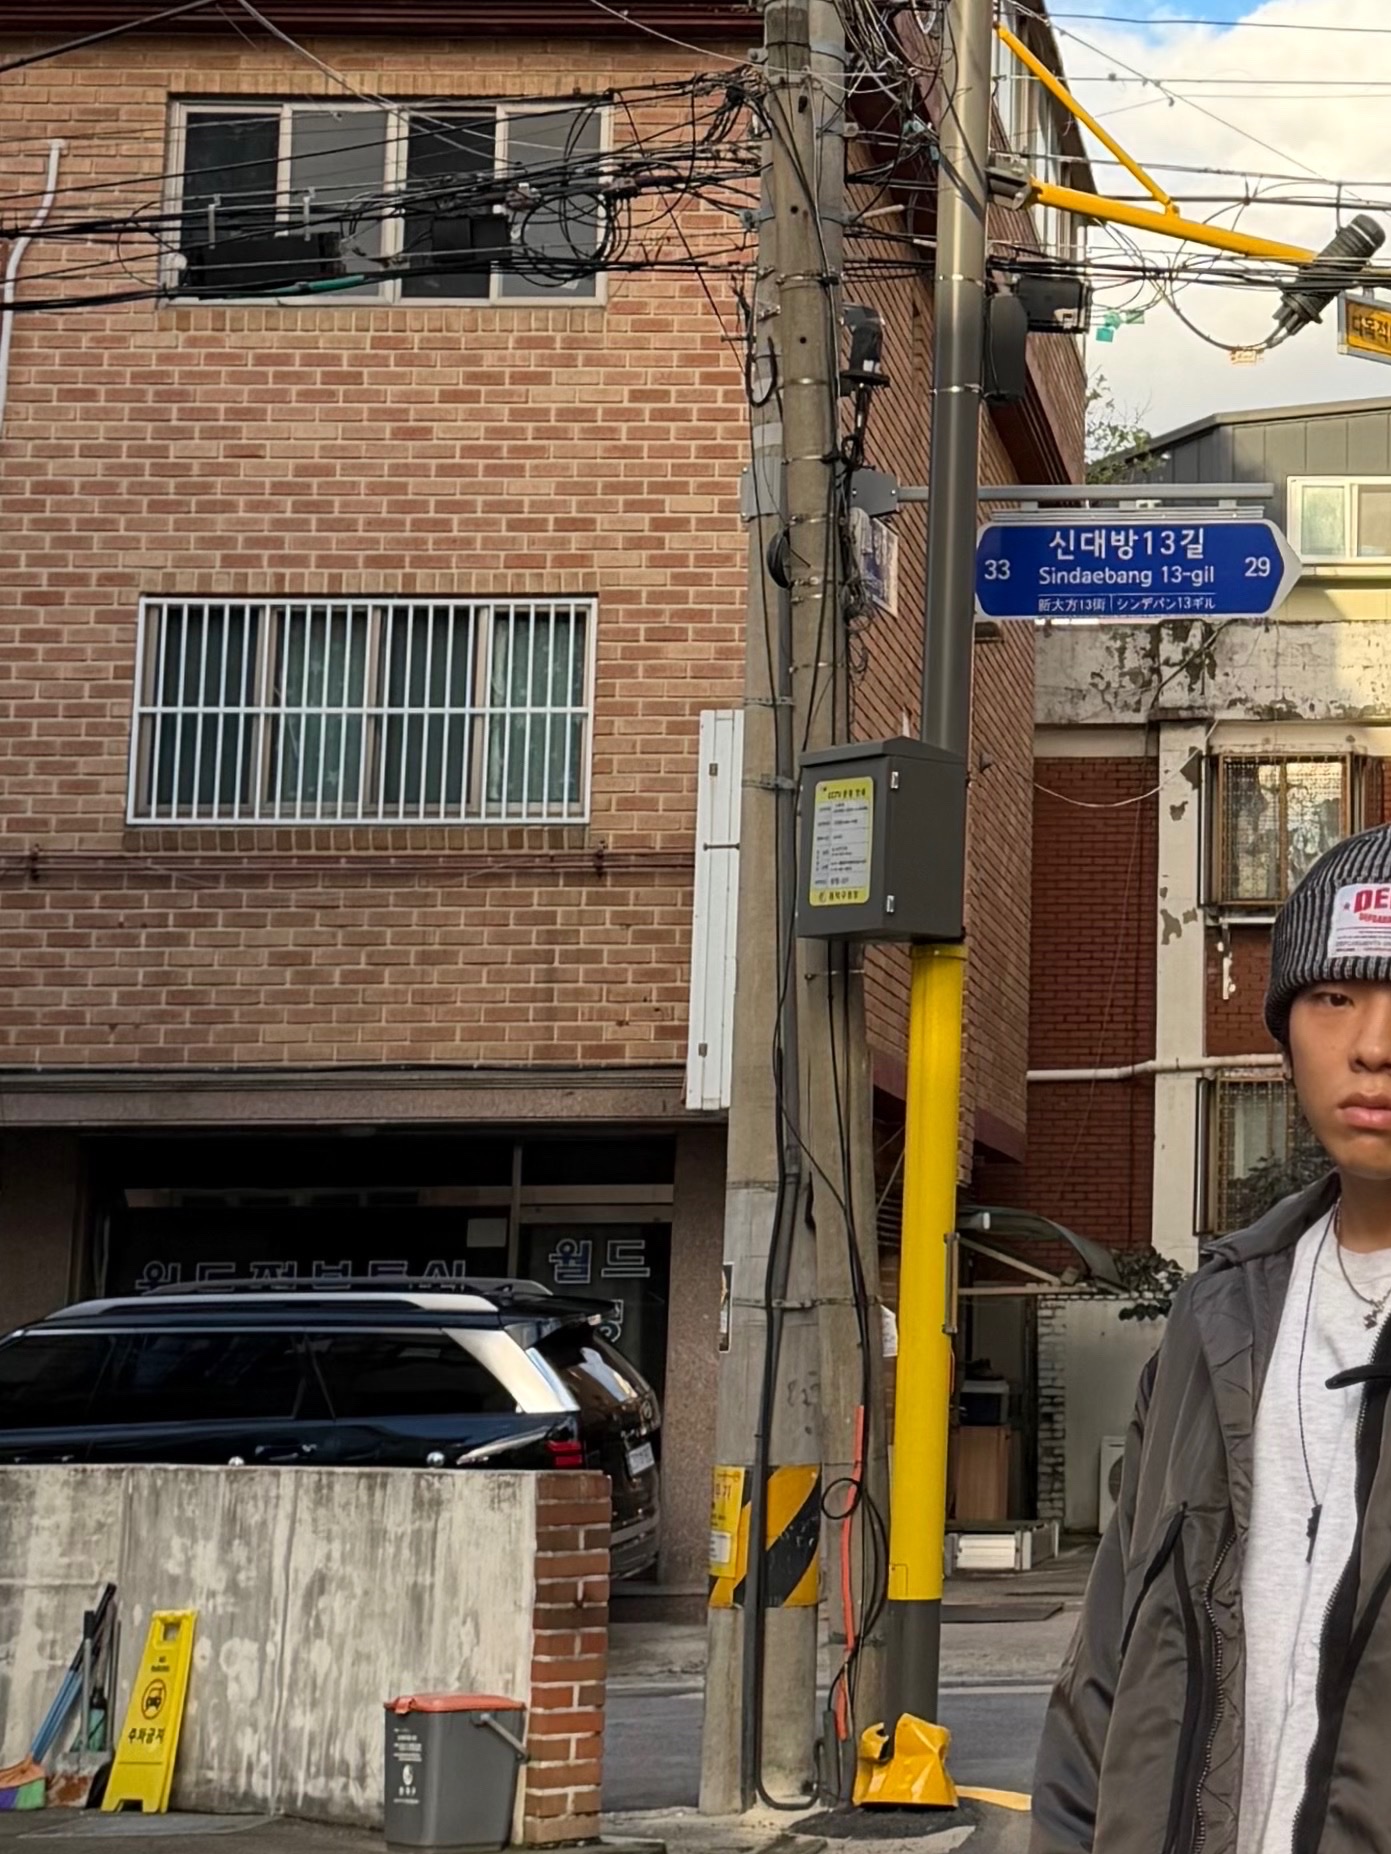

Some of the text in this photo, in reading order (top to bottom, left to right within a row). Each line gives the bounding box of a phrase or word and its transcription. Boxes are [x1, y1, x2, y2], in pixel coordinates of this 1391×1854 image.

[1049, 527, 1204, 560] 신대방13길
[984, 559, 1011, 580] 33
[1039, 565, 1215, 587] Sindaebang 13-gil
[1244, 556, 1271, 578] 29
[548, 1238, 651, 1285] 월드
[128, 1727, 165, 1746] 주차금지
